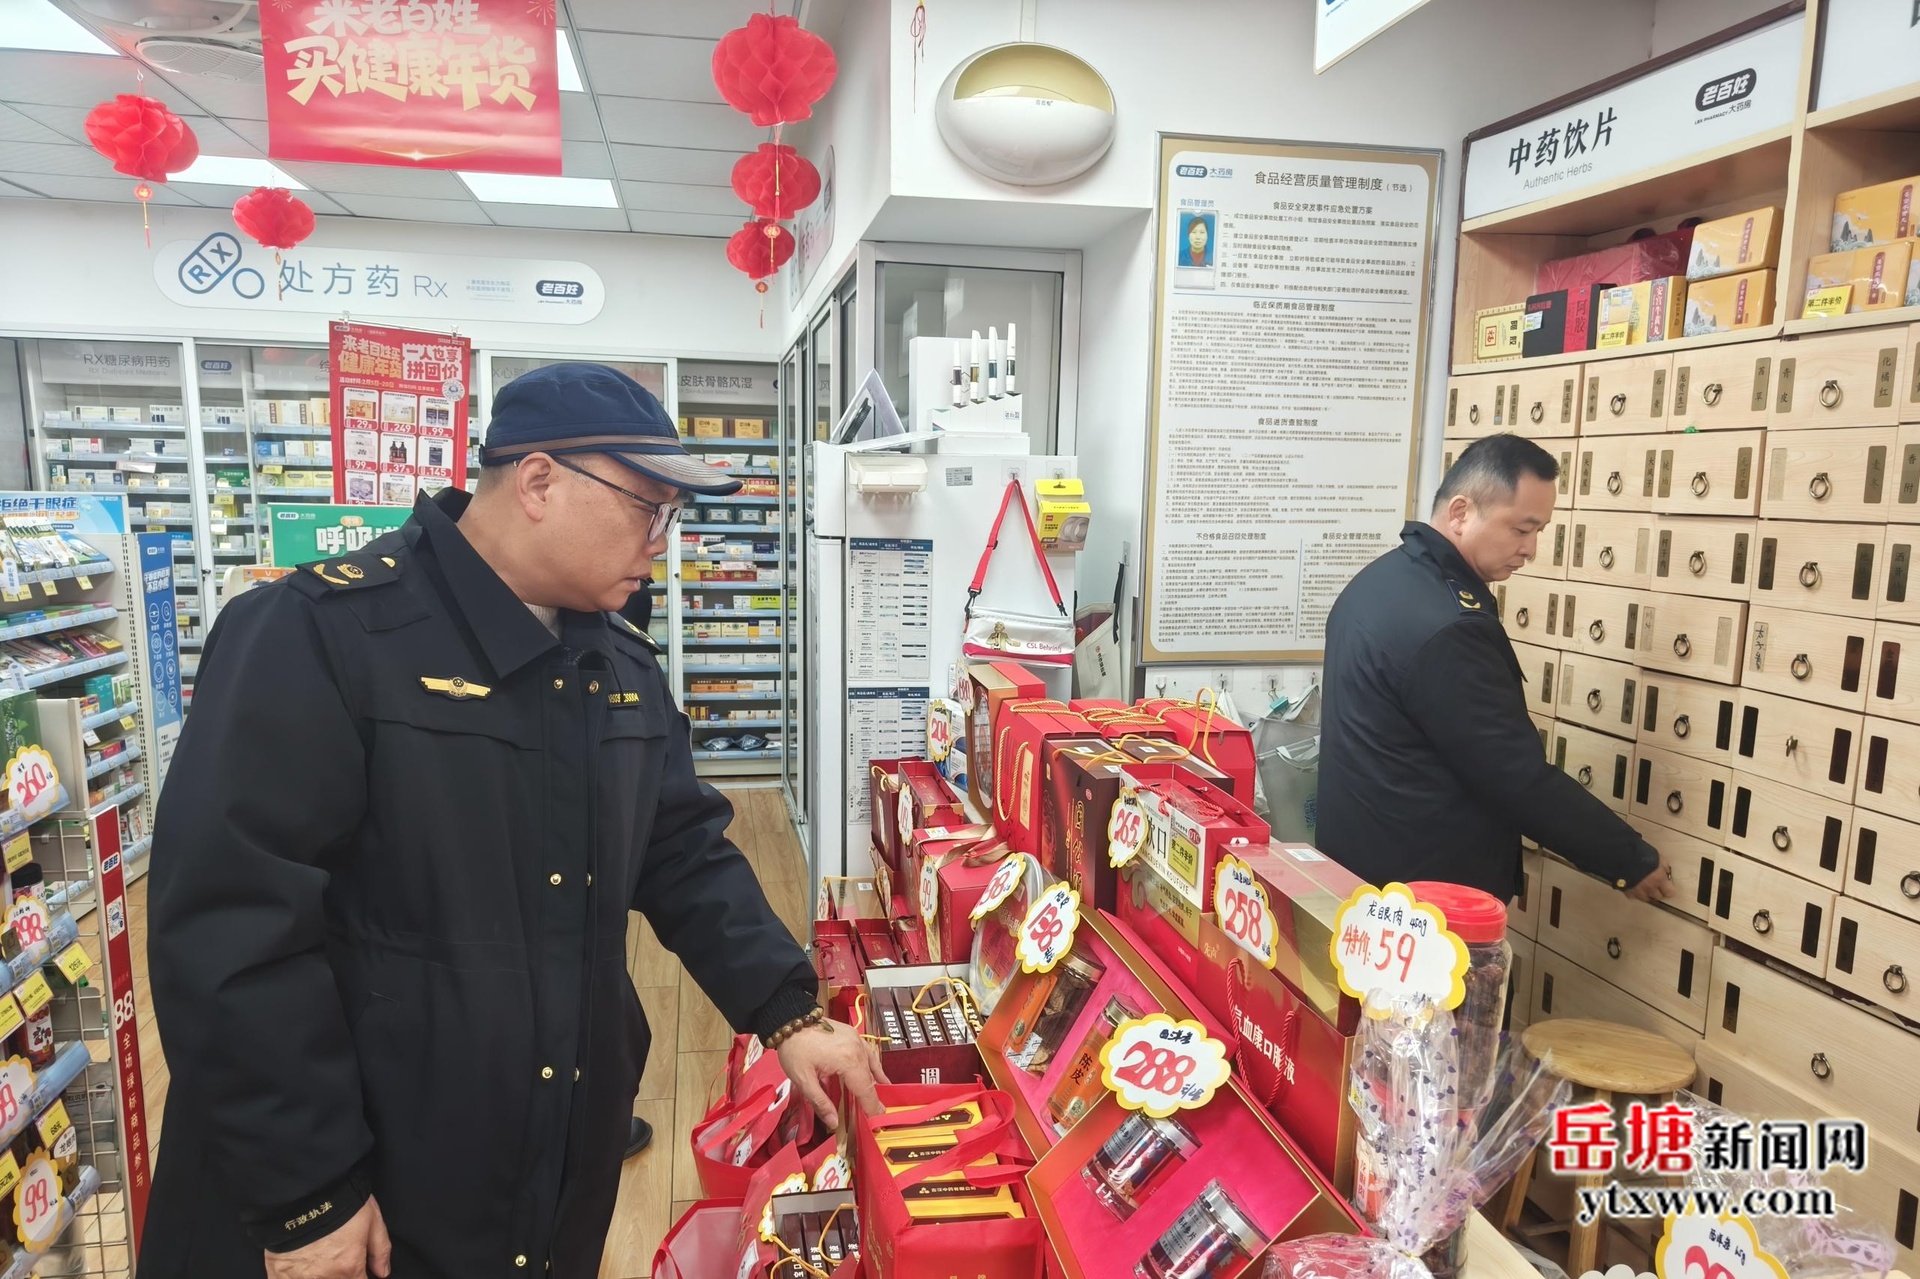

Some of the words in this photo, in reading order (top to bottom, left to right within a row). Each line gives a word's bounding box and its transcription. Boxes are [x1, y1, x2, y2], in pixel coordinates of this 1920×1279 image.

[284, 36, 537, 111] 买健康年货
[1702, 74, 1750, 106] 老百姓
[1508, 106, 1618, 176] 中药饮片
[1254, 170, 1384, 191] 食品经营质量管理制度
[1522, 170, 1565, 190] Authentic
[1566, 160, 1593, 181] Herbs
[278, 259, 400, 298] 处方药
[413, 275, 449, 299] Rx
[1807, 296, 1842, 308] 第二件半价
[84, 353, 171, 368] RX糖尿病用药
[1902, 453, 1918, 495] 香附
[1039, 643, 1063, 653] Behring
[931, 718, 949, 744] 204
[17, 762, 47, 808] 260
[1113, 809, 1141, 847] 265
[1224, 887, 1262, 948] 258
[1366, 899, 1403, 926] 龙眼肉
[1374, 927, 1417, 983] 59
[114, 989, 135, 1031] 88
[1069, 1052, 1093, 1086] 陈皮
[1114, 1039, 1197, 1096] 288
[24, 1178, 48, 1224] 99
[284, 1201, 333, 1231] 行政执法
